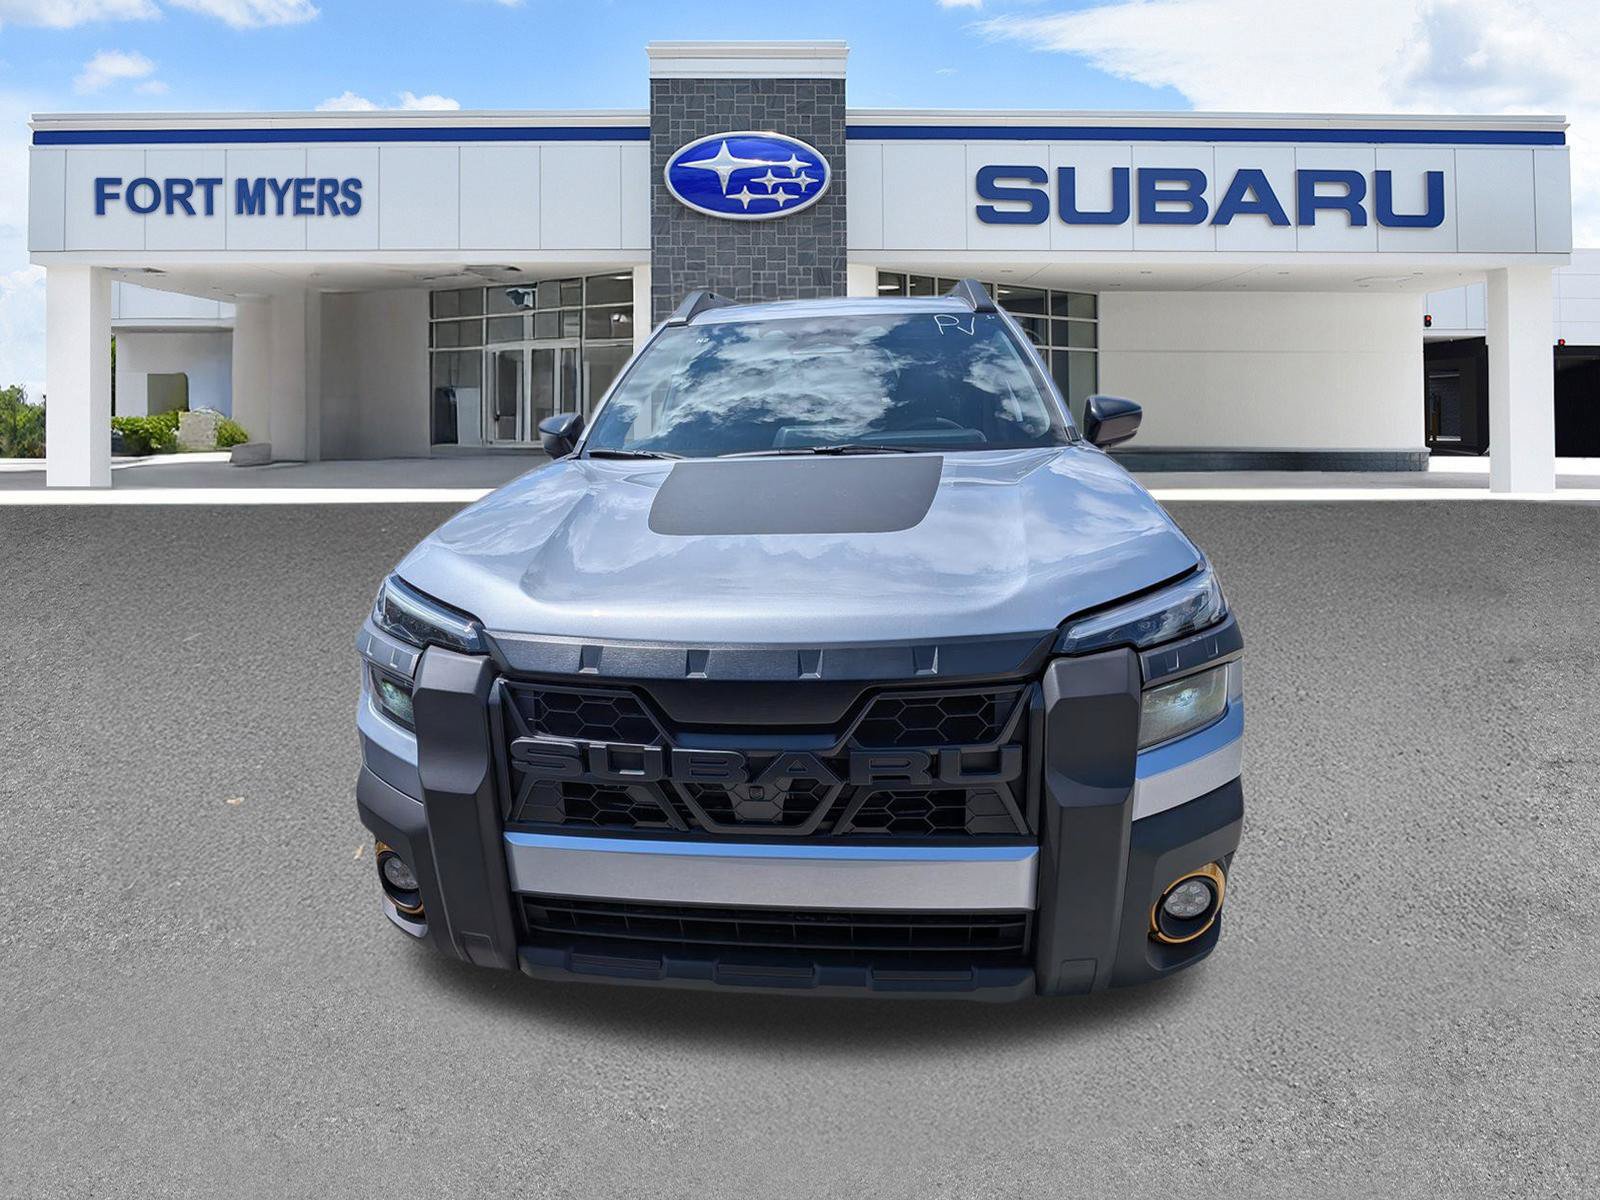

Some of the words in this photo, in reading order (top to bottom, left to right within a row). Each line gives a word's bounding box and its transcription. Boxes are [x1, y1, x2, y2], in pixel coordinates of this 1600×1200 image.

[93, 177, 223, 217] FORT
[235, 177, 363, 217] MYERS
[974, 165, 1446, 229] SUBARU
[509, 738, 1023, 785] SUBARU
